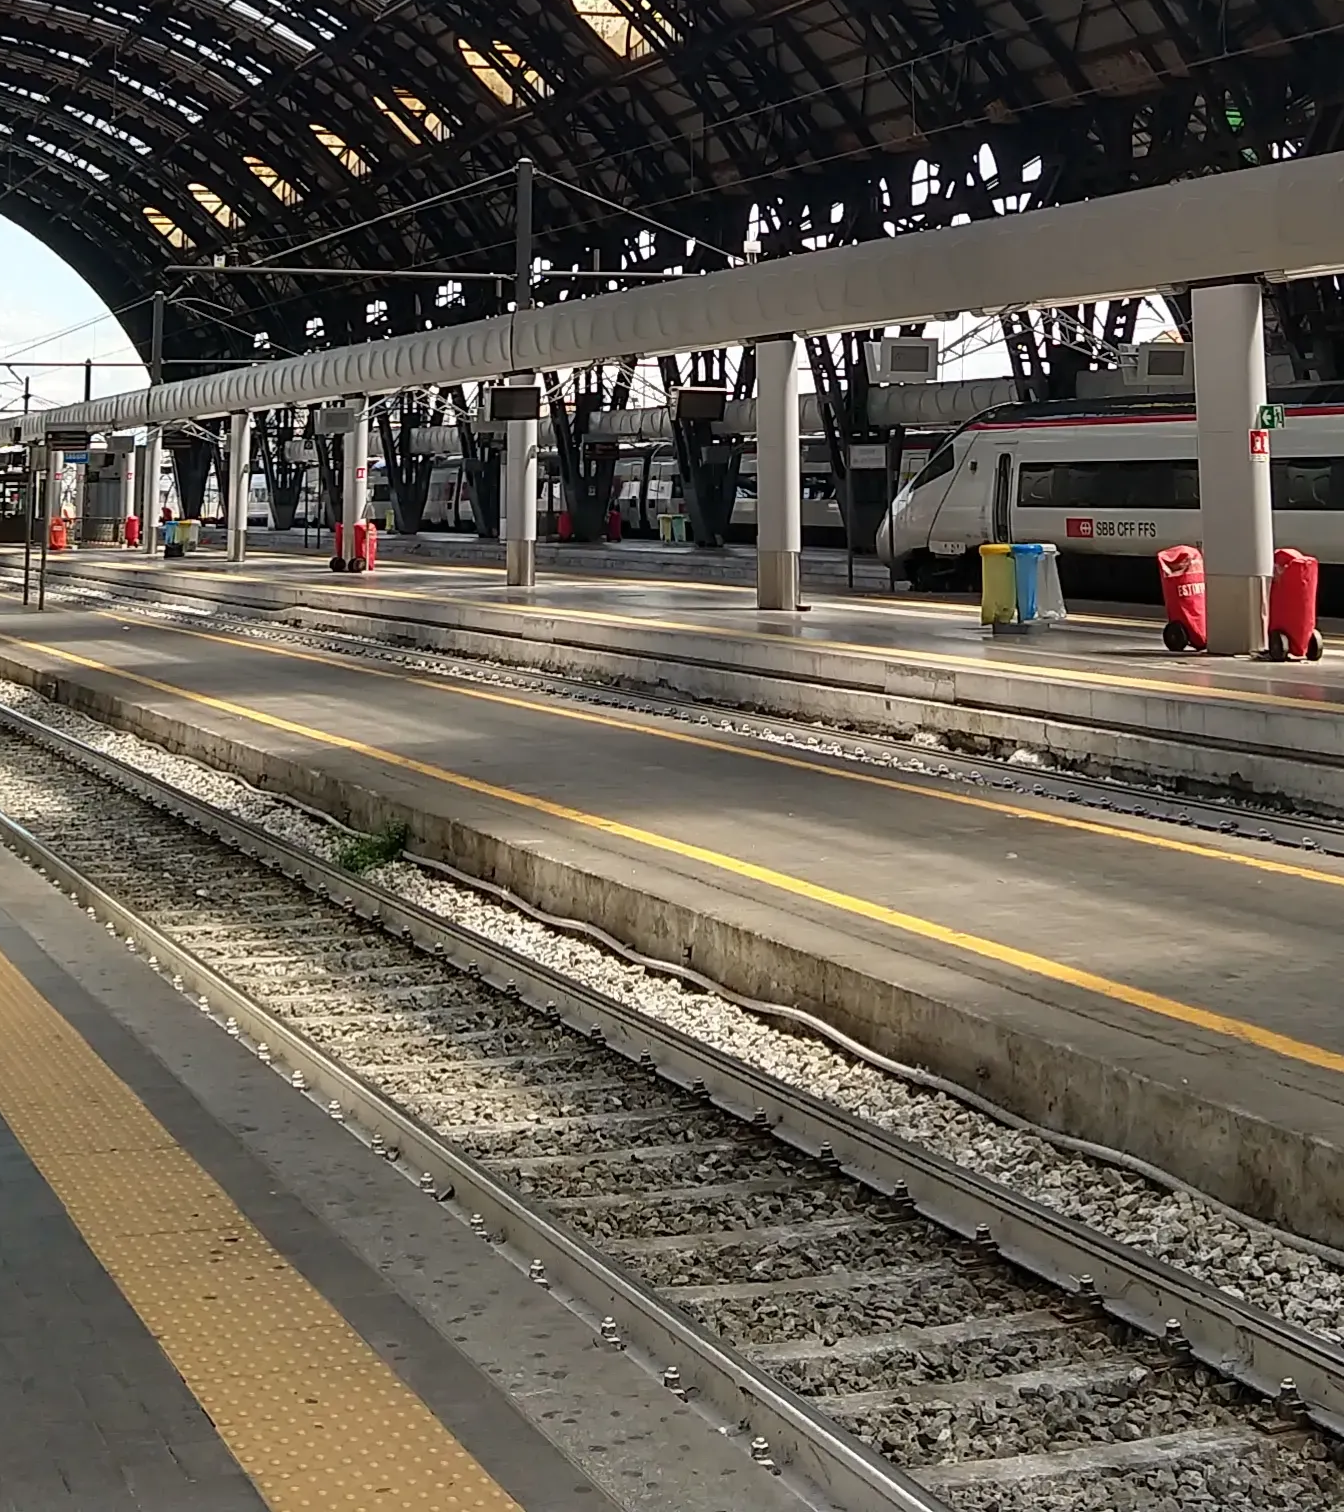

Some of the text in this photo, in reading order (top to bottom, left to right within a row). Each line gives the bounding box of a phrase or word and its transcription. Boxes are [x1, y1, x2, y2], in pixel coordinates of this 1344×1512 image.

[1096, 521, 1156, 537] SBB CFF FFS
